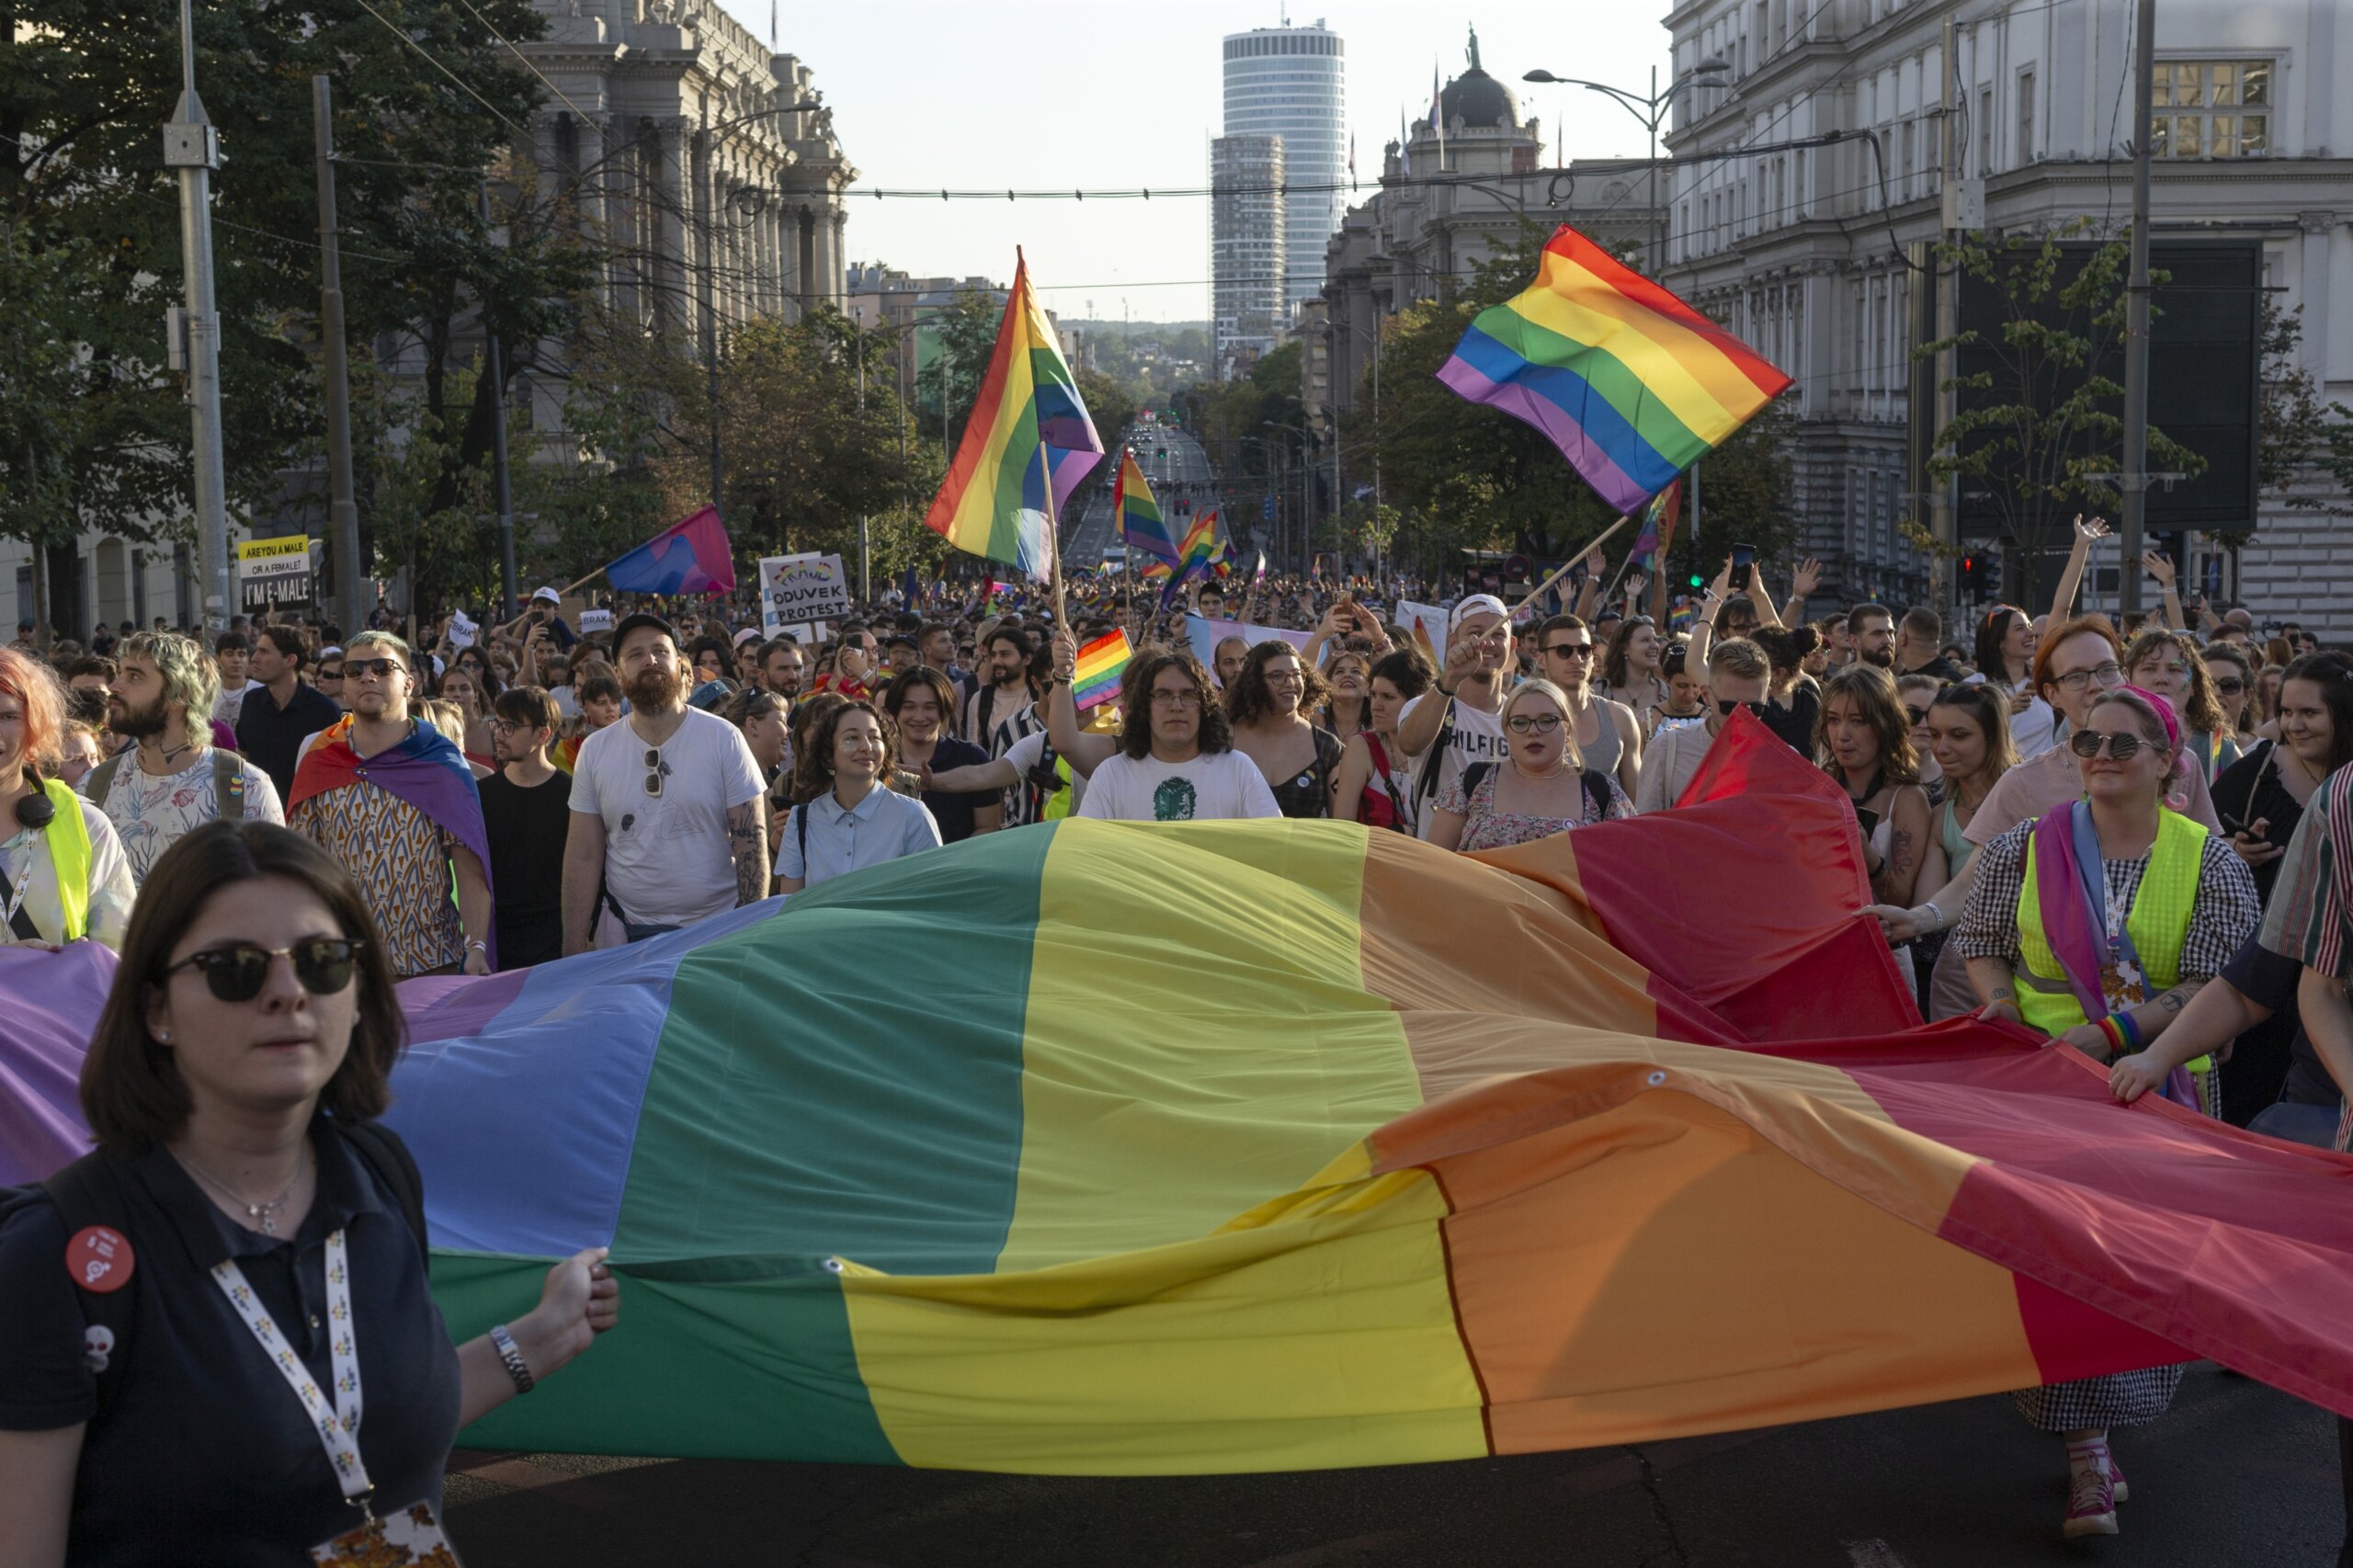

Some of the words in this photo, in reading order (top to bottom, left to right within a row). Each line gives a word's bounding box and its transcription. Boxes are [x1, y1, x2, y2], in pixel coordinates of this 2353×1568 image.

[278, 545, 284, 555] A
[284, 542, 303, 553] MALE
[252, 564, 264, 574] OR
[265, 564, 270, 574] A
[271, 560, 301, 573] FEMALE?
[246, 584, 265, 606] I'M
[267, 578, 309, 603] E-MALE
[773, 585, 842, 605] ODUVEK
[778, 601, 845, 621] PROTEST
[583, 615, 608, 625] BRAK
